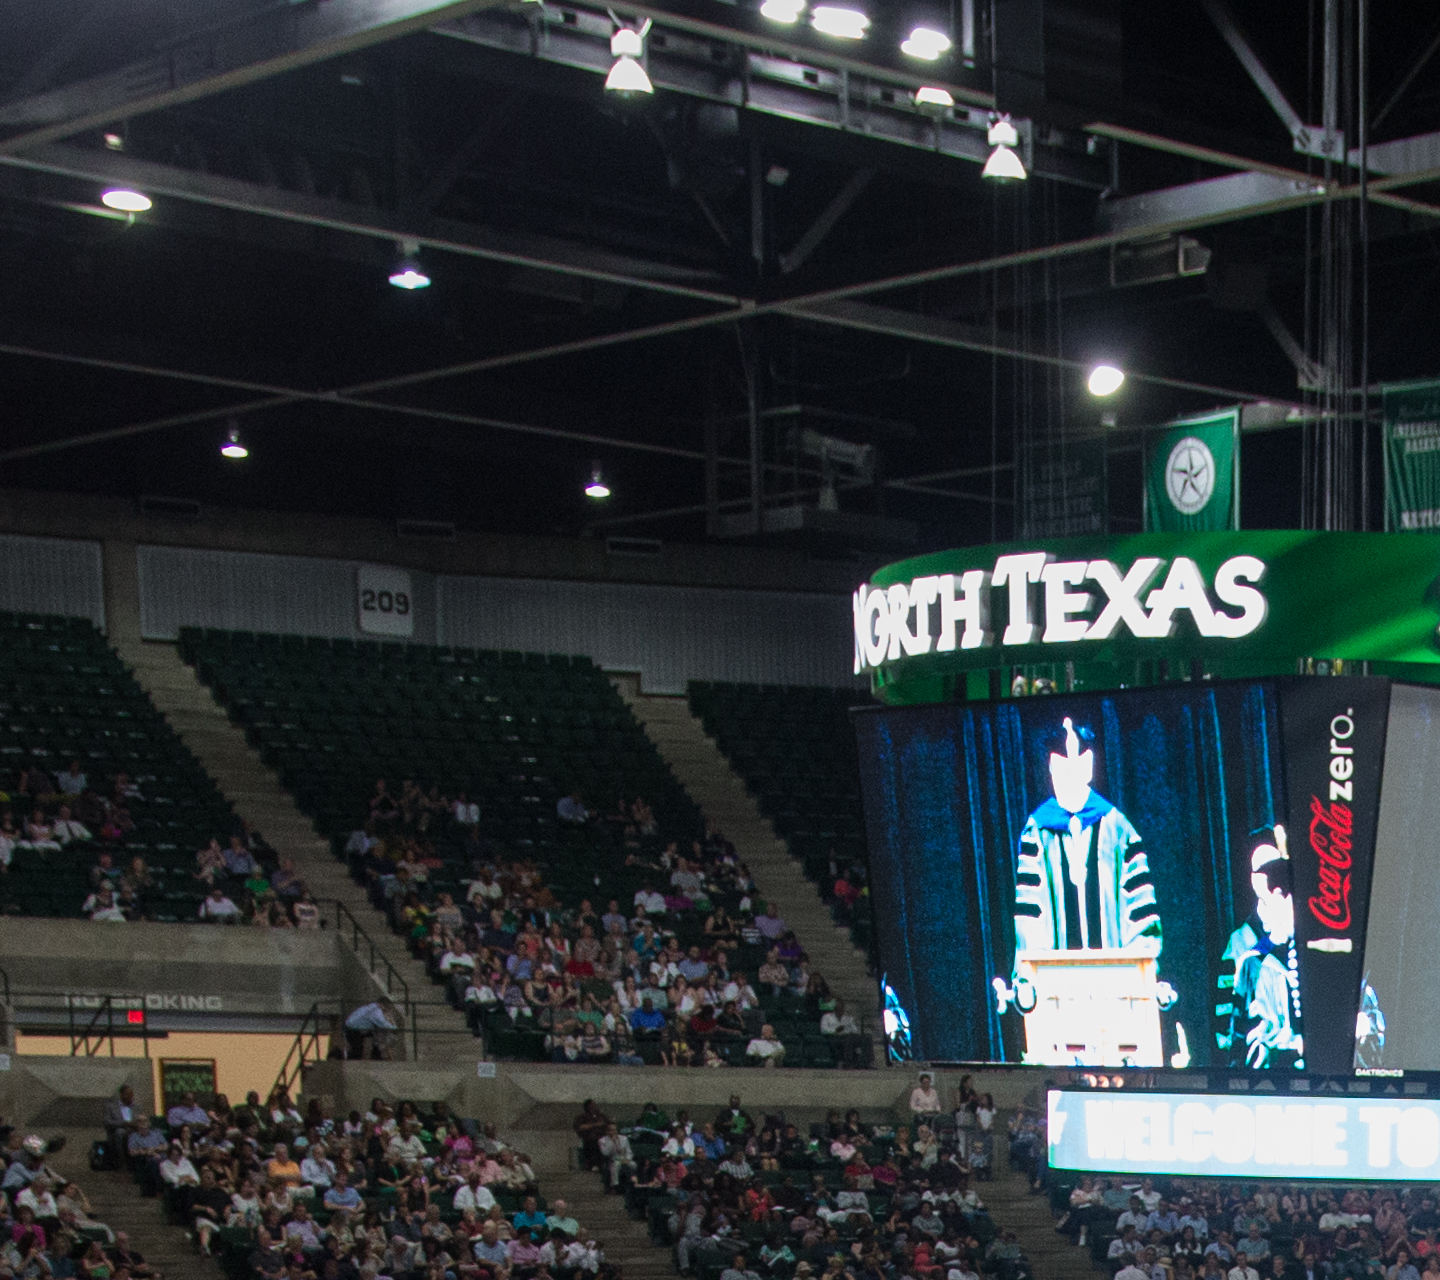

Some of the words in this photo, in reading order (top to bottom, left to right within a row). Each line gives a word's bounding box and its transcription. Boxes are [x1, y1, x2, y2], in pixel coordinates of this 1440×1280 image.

[362, 590, 409, 615] 209
[853, 568, 984, 675] NORTH
[991, 551, 1268, 646] TEXAS
[1308, 794, 1354, 930] Coca-Cola
[1085, 1100, 1348, 1166] WELCOME
[1360, 1107, 1440, 1168] TO
